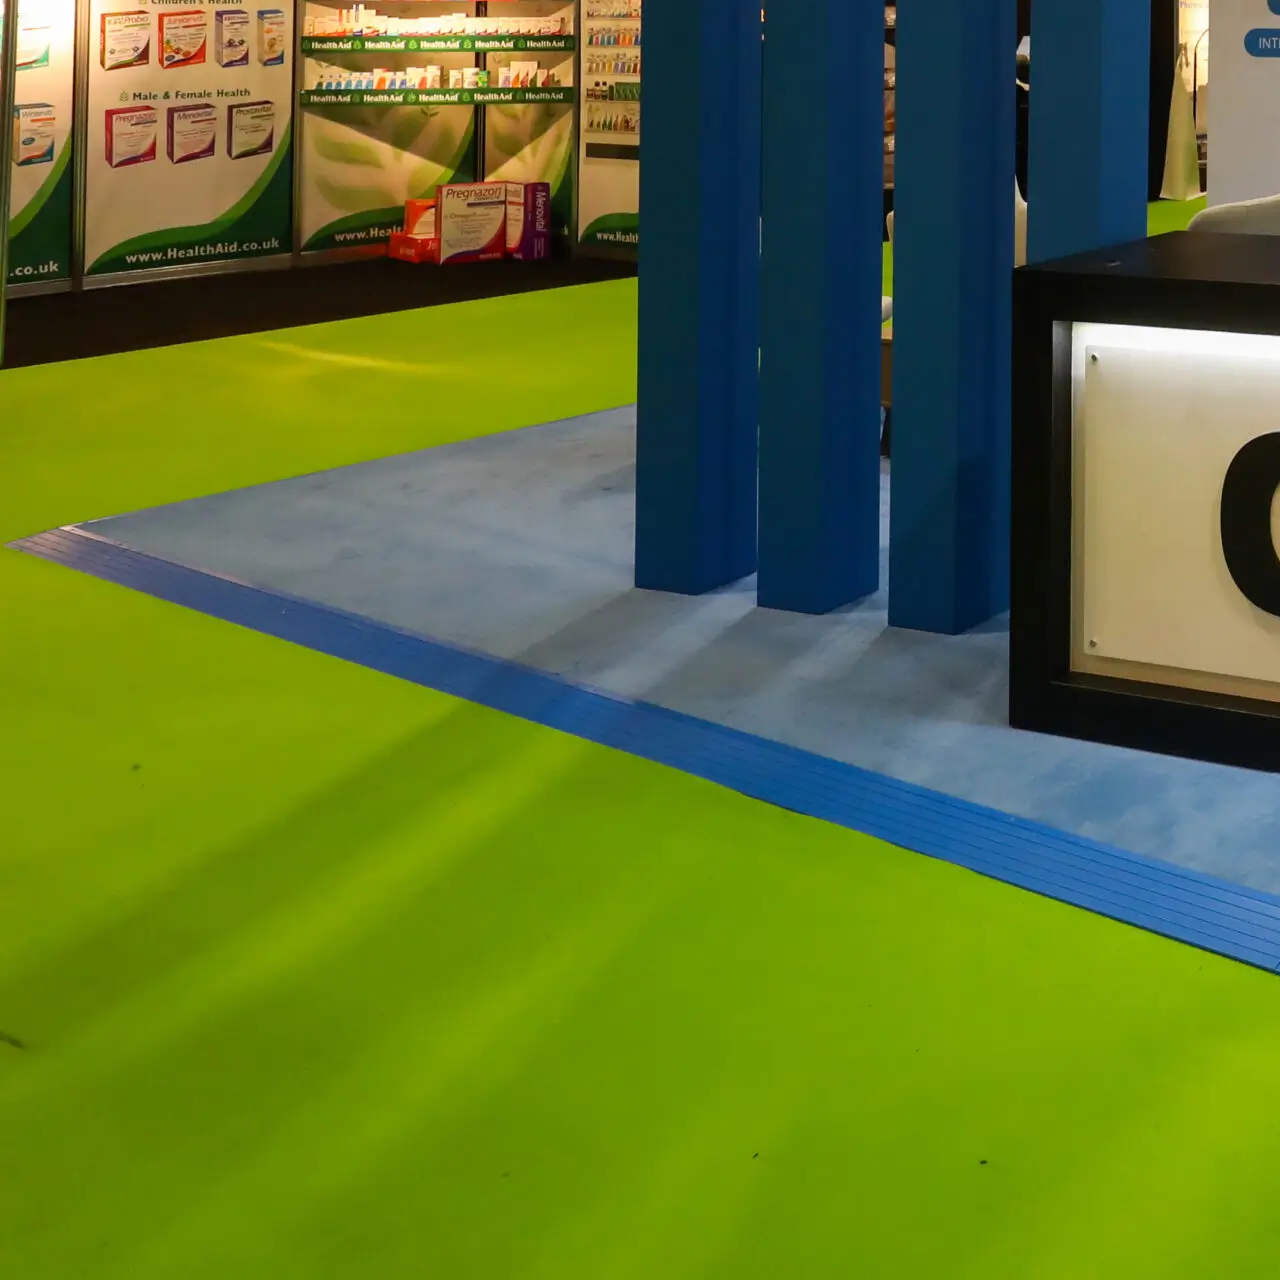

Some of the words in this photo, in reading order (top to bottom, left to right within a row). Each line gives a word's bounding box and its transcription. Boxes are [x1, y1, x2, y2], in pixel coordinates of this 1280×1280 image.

[132, 92, 158, 101] Male
[162, 92, 170, 100] &
[175, 91, 213, 100] Female
[217, 89, 250, 97] Health
[446, 187, 502, 200] Pregnazon
[126, 237, 280, 264] www.HealthAid.co.uk
